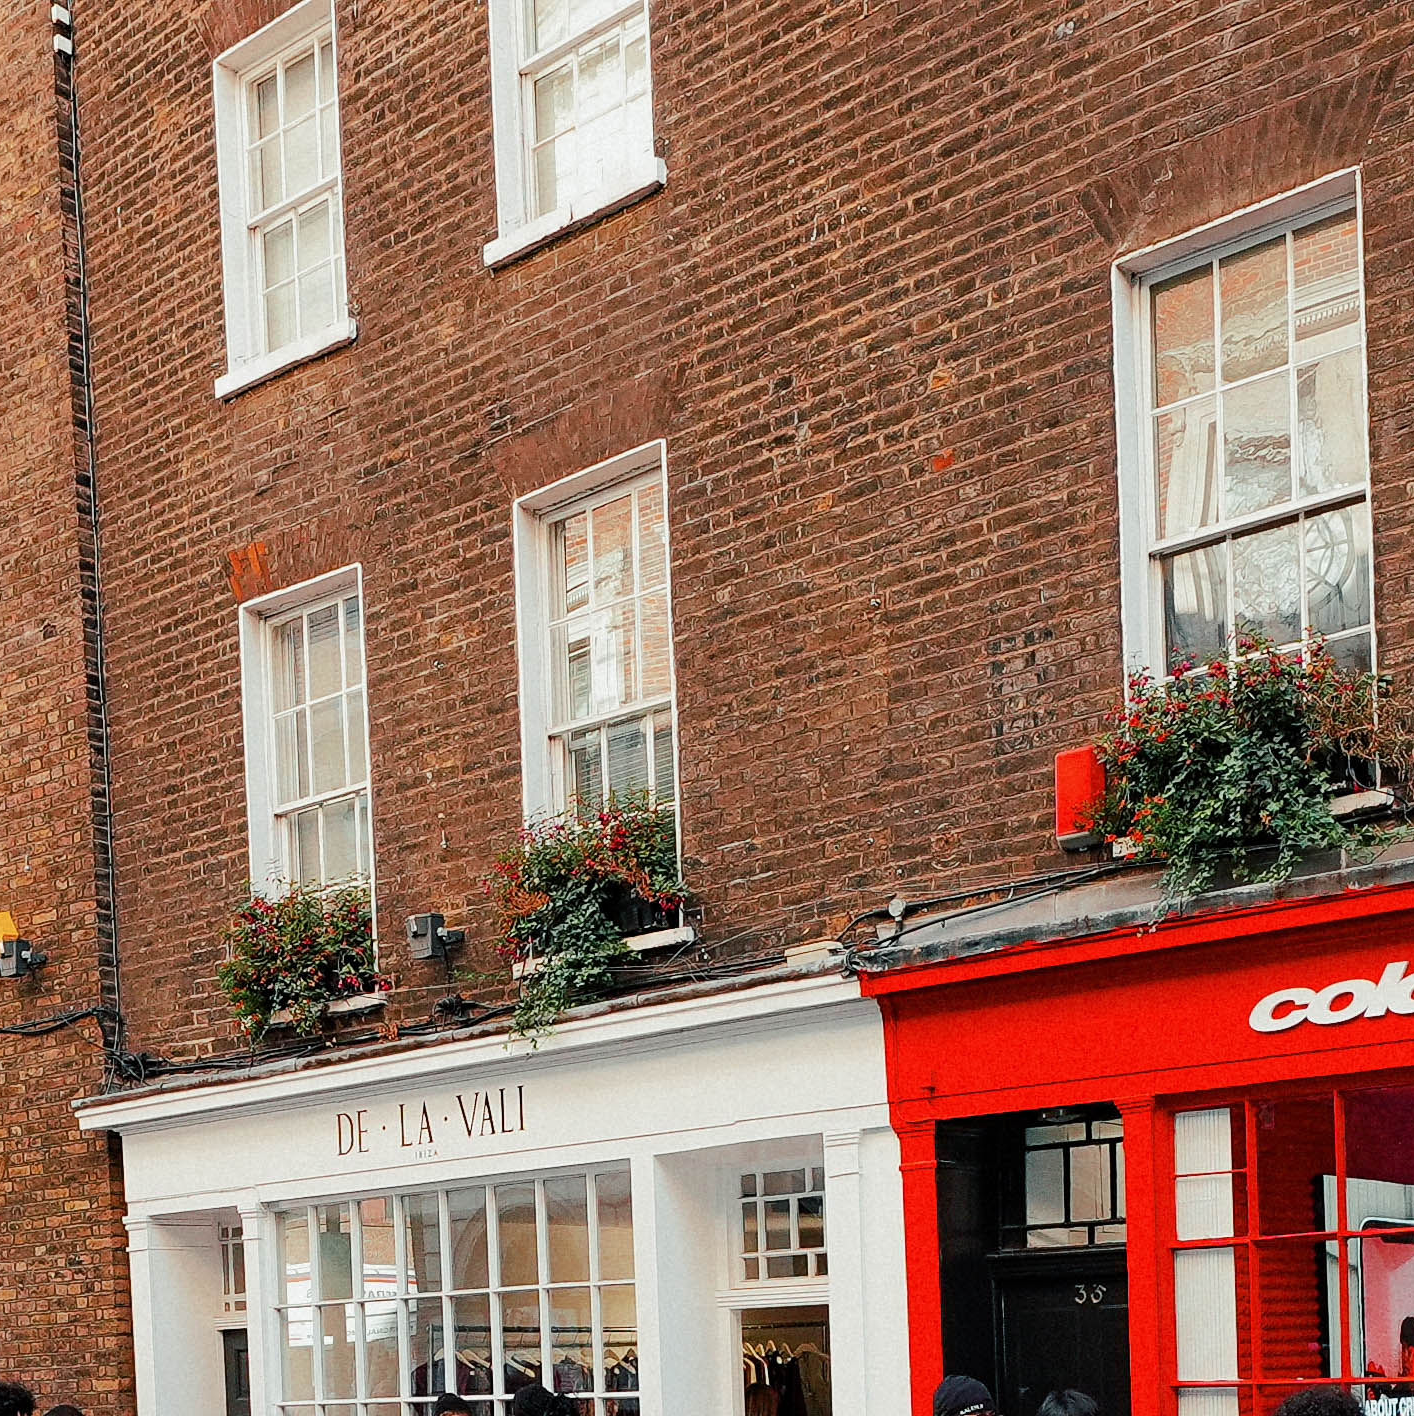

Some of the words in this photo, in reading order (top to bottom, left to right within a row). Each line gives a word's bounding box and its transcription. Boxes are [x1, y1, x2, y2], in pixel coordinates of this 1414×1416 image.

[337, 1110, 369, 1155] DE
[399, 1100, 434, 1147] LA
[456, 1085, 525, 1138] VALI
